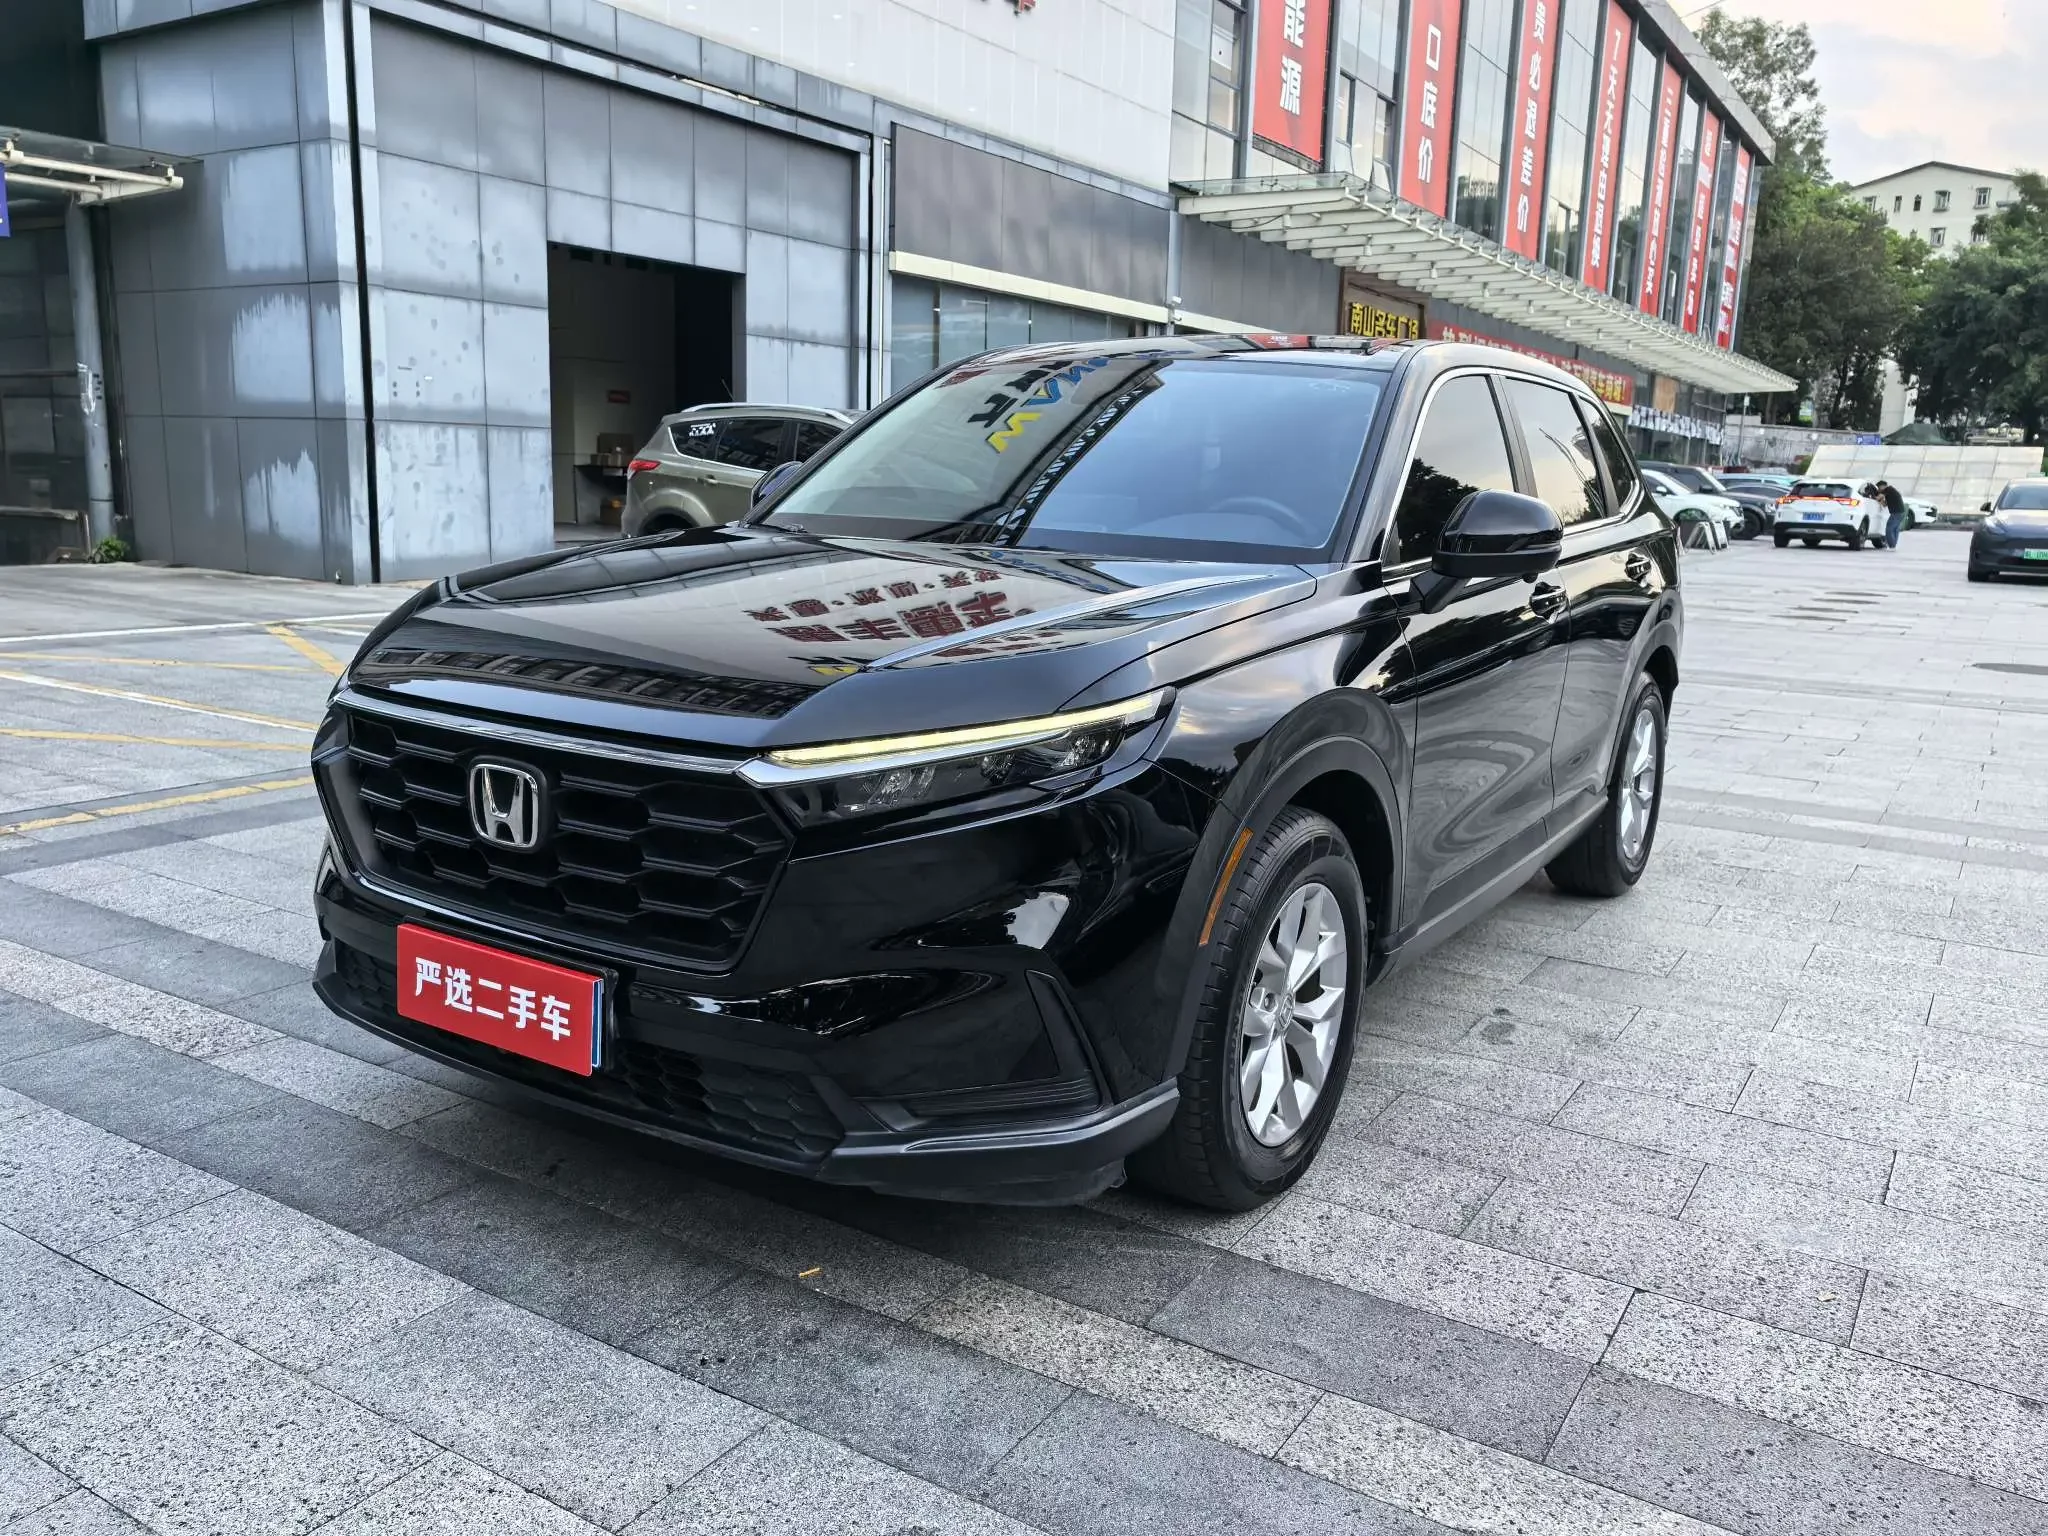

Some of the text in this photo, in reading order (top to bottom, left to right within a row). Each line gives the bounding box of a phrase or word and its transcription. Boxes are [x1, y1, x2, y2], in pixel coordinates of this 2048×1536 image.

[1279, 0, 1306, 116] 能源
[1417, 23, 1442, 184] 口底价
[1351, 302, 1419, 340] 南山名车广场
[415, 956, 571, 1042] 严选二手车
